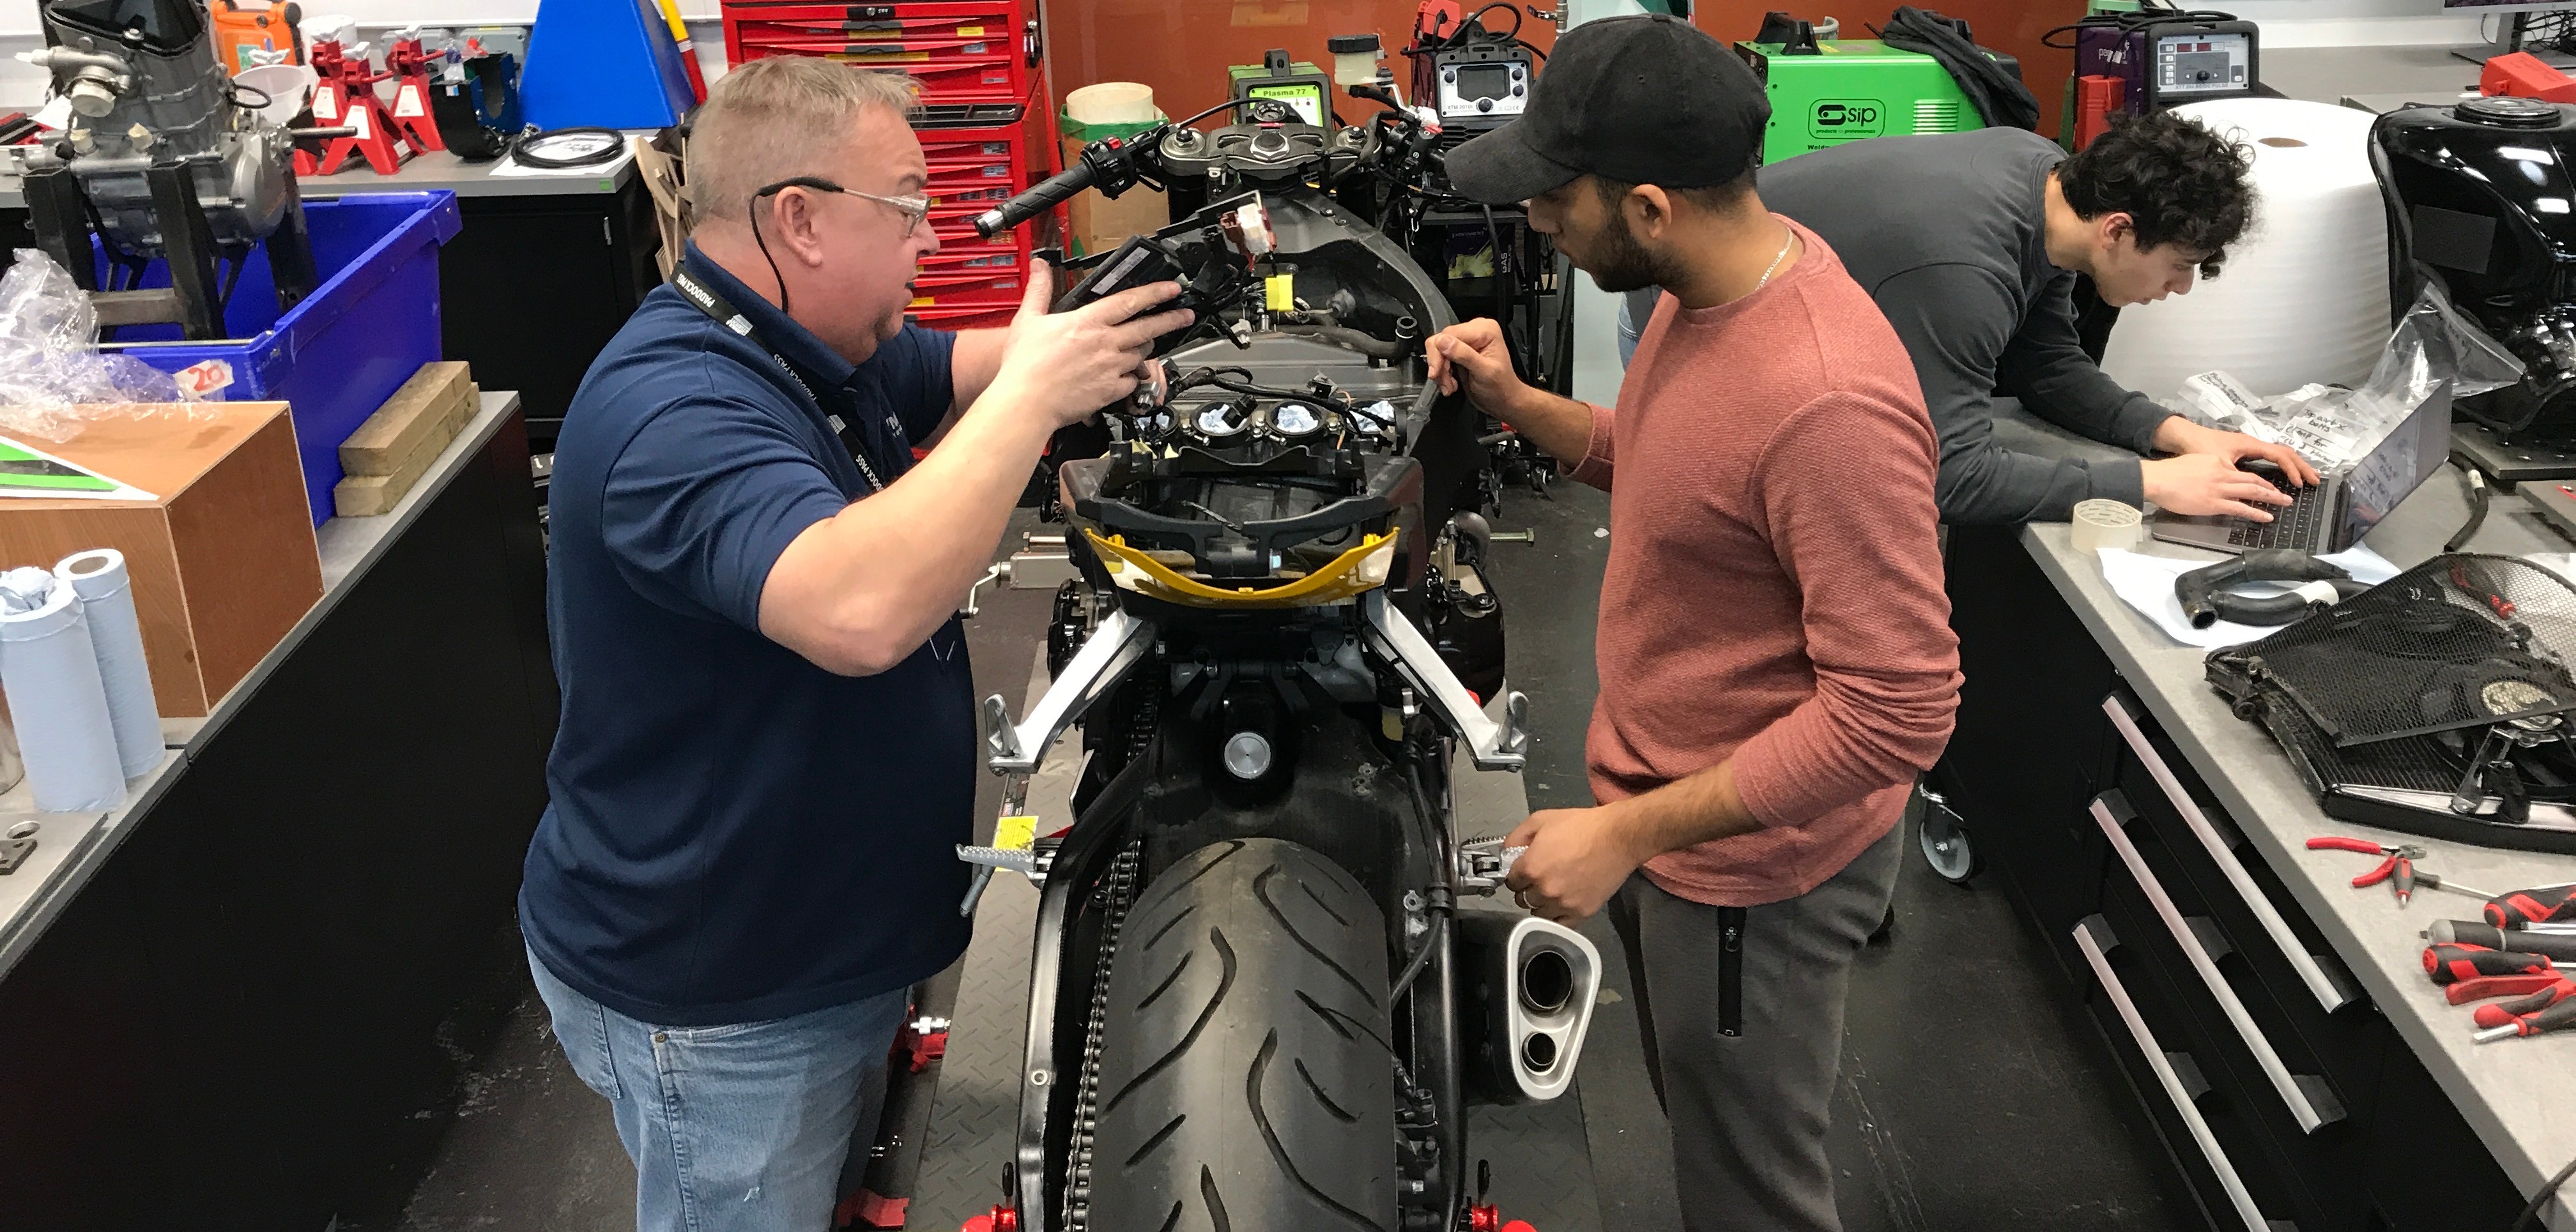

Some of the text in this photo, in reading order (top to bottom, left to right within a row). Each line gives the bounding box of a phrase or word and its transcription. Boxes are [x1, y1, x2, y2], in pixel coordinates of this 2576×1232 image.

[684, 280, 716, 308] PADDOCK
[187, 365, 225, 391] 20
[856, 454, 869, 473] PASS
